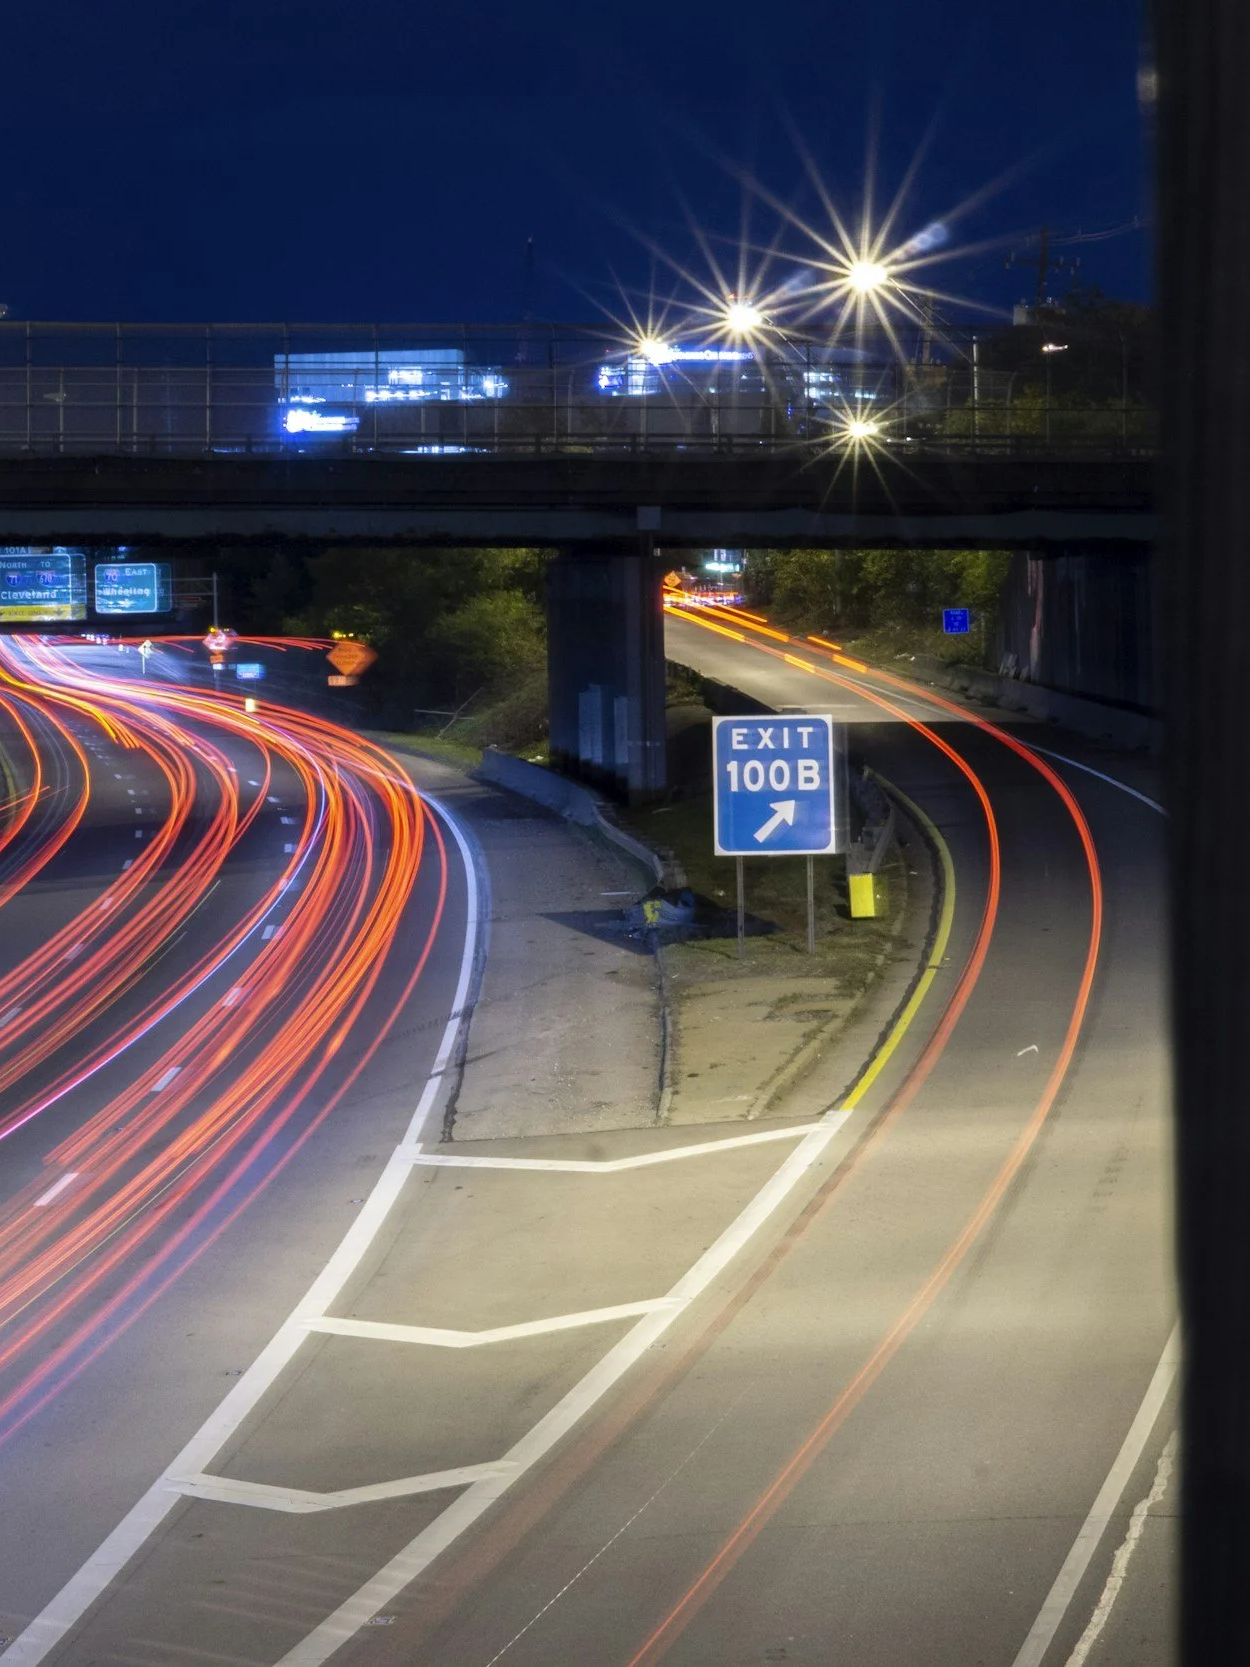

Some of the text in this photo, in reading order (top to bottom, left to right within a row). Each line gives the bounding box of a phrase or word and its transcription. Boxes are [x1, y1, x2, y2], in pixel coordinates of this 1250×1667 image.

[0, 561, 27, 569] NORTH
[8, 575, 18, 584] 71
[106, 568, 148, 582] 70 EAST
[0, 590, 57, 600] Cleveland
[732, 727, 814, 749] EXIT
[727, 759, 821, 792] 100B
